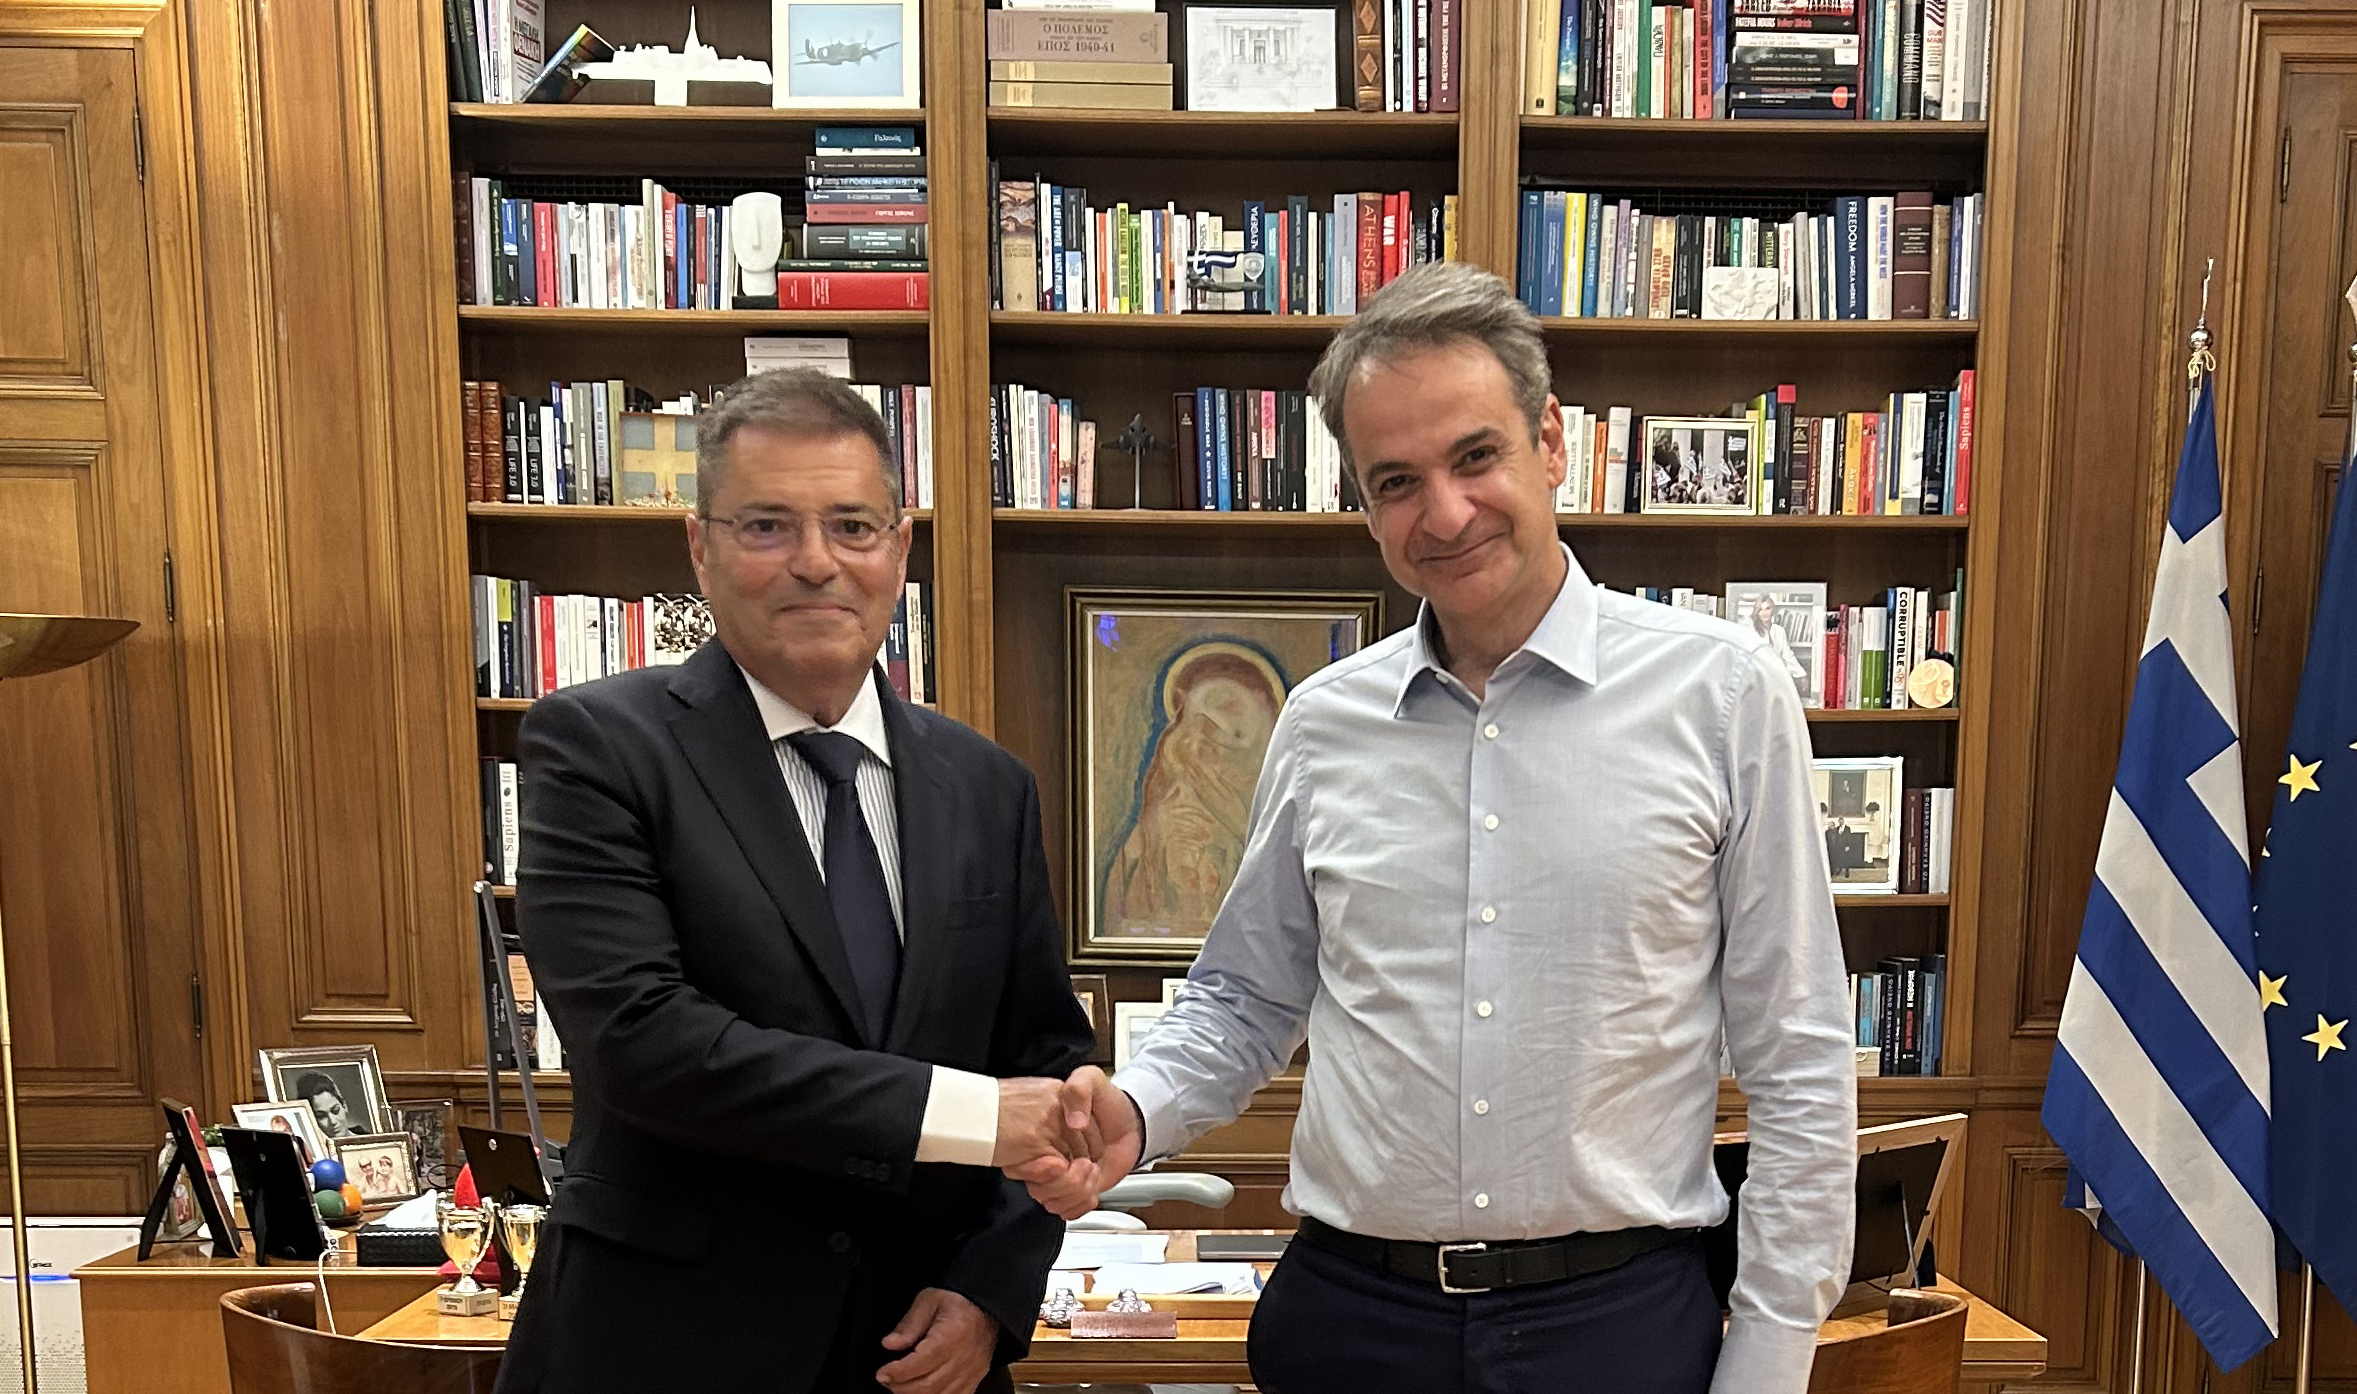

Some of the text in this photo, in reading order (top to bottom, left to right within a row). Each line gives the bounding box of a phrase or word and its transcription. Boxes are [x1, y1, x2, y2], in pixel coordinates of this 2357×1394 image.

[1037, 40, 1115, 53] ΕΠΟΣ 1940-41
[1043, 23, 1109, 35] Ο ΠΟΛΕΜΟΣ
[1902, 33, 1921, 84] COMMAND
[1053, 194, 1062, 206] THE
[1053, 207, 1062, 219] ART
[1053, 226, 1062, 247] POWER
[1362, 204, 1377, 268] ATHENS
[1383, 214, 1395, 245] WAR
[1587, 199, 1599, 287] WHO OWNS HISTORY?
[1848, 201, 1858, 253] FREEDOM
[1054, 253, 1063, 273] NANCY
[1765, 231, 1774, 268] MITTERRAN
[1782, 230, 1791, 275] Rory Stewart
[1054, 274, 1063, 295] PELOSI
[1218, 393, 1228, 480] WHO OWNS HISTORY?
[1959, 406, 1972, 451] Sapiens
[508, 457, 517, 486] LIFE 3.0
[530, 458, 539, 487] LIFE 3.0
[1569, 441, 1577, 495] MONTPELLIER
[1895, 591, 1908, 667] CORRUPTIBLE
[502, 801, 516, 852] Sapiens
